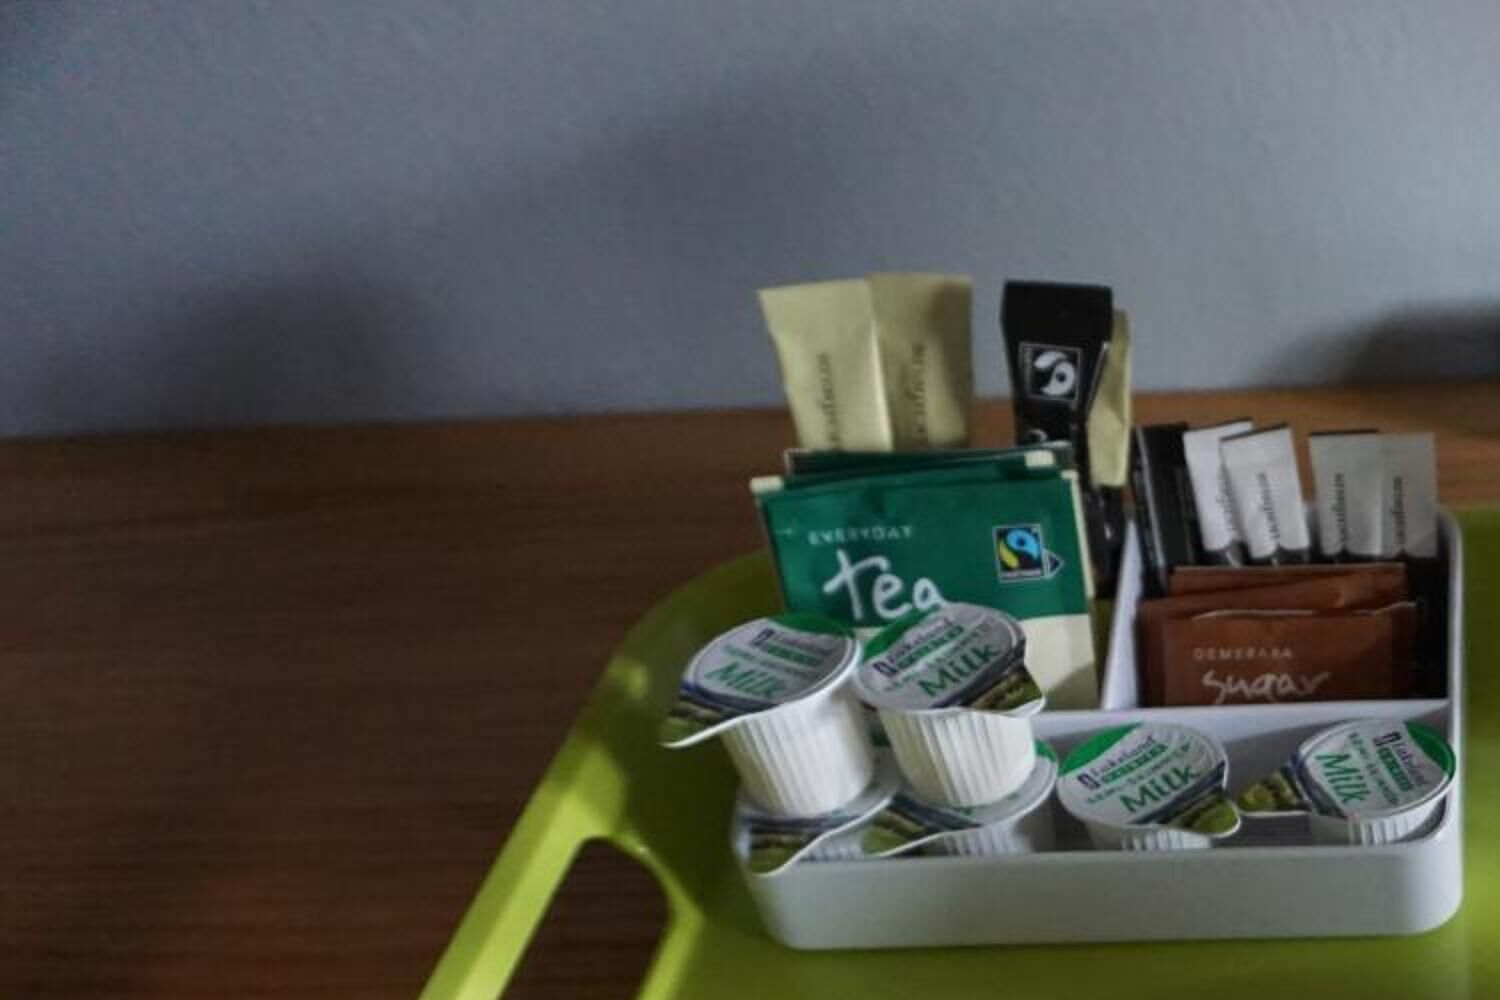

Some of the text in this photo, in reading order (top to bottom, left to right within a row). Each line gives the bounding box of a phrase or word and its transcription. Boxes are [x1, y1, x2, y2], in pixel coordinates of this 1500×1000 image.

[808, 525, 914, 545] EVERYDAY
[918, 643, 1000, 697] Milk
[1192, 646, 1294, 661] DEMERARA
[703, 661, 786, 698] Milk
[1119, 764, 1201, 813] Milk
[1315, 752, 1371, 804] Milk
